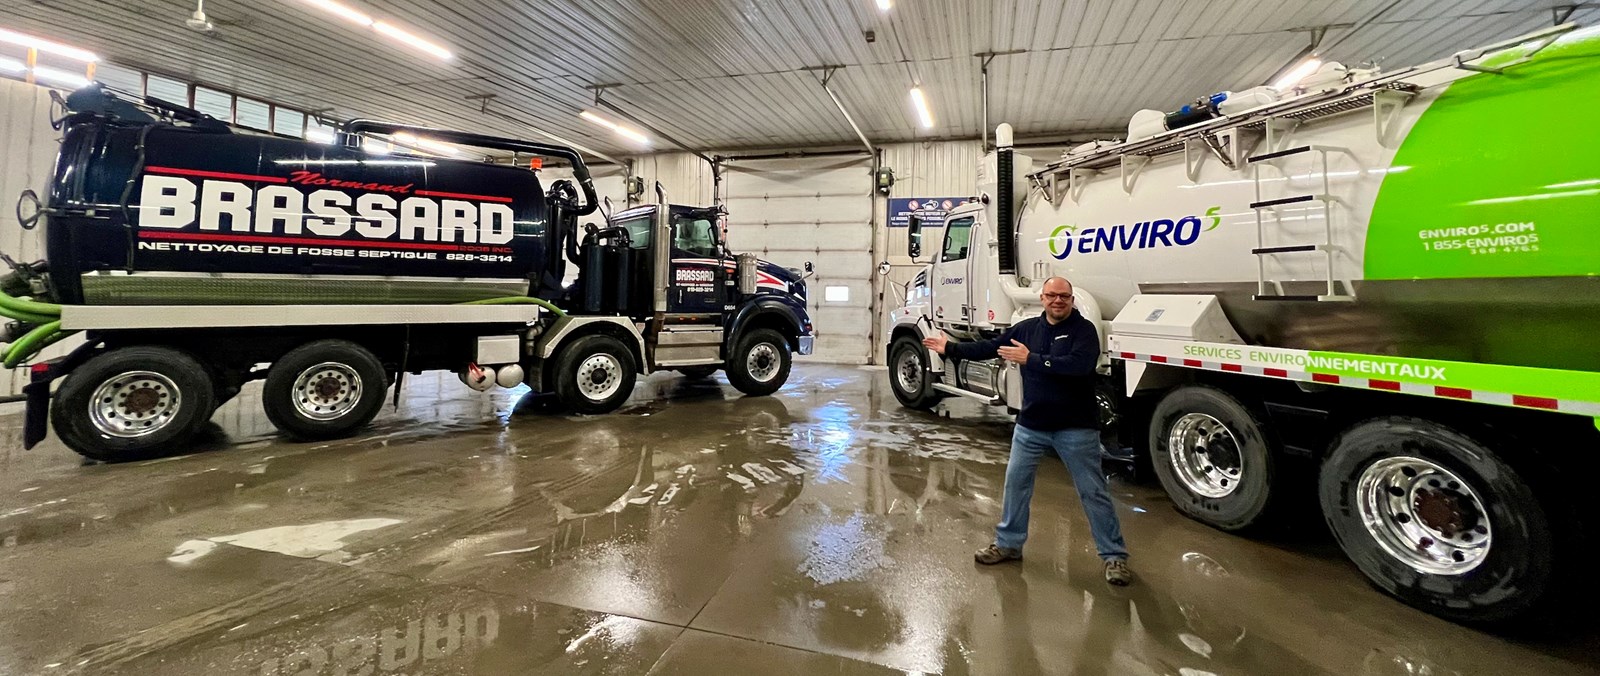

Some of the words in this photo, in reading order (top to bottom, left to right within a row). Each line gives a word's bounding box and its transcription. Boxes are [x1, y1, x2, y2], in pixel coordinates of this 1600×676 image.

[290, 170, 414, 194] Normand
[139, 174, 514, 245] BRASSARD
[138, 241, 264, 254] NETTOYAGE
[267, 246, 294, 255] DE
[297, 247, 355, 257] FOSSE
[358, 250, 437, 260] SEPTIQUE
[446, 253, 513, 263] 828-3214
[676, 269, 714, 282] BRASSARD
[1183, 345, 1242, 360] SERVICES
[1249, 351, 1447, 381] ENVIRONNEMENTAUX
